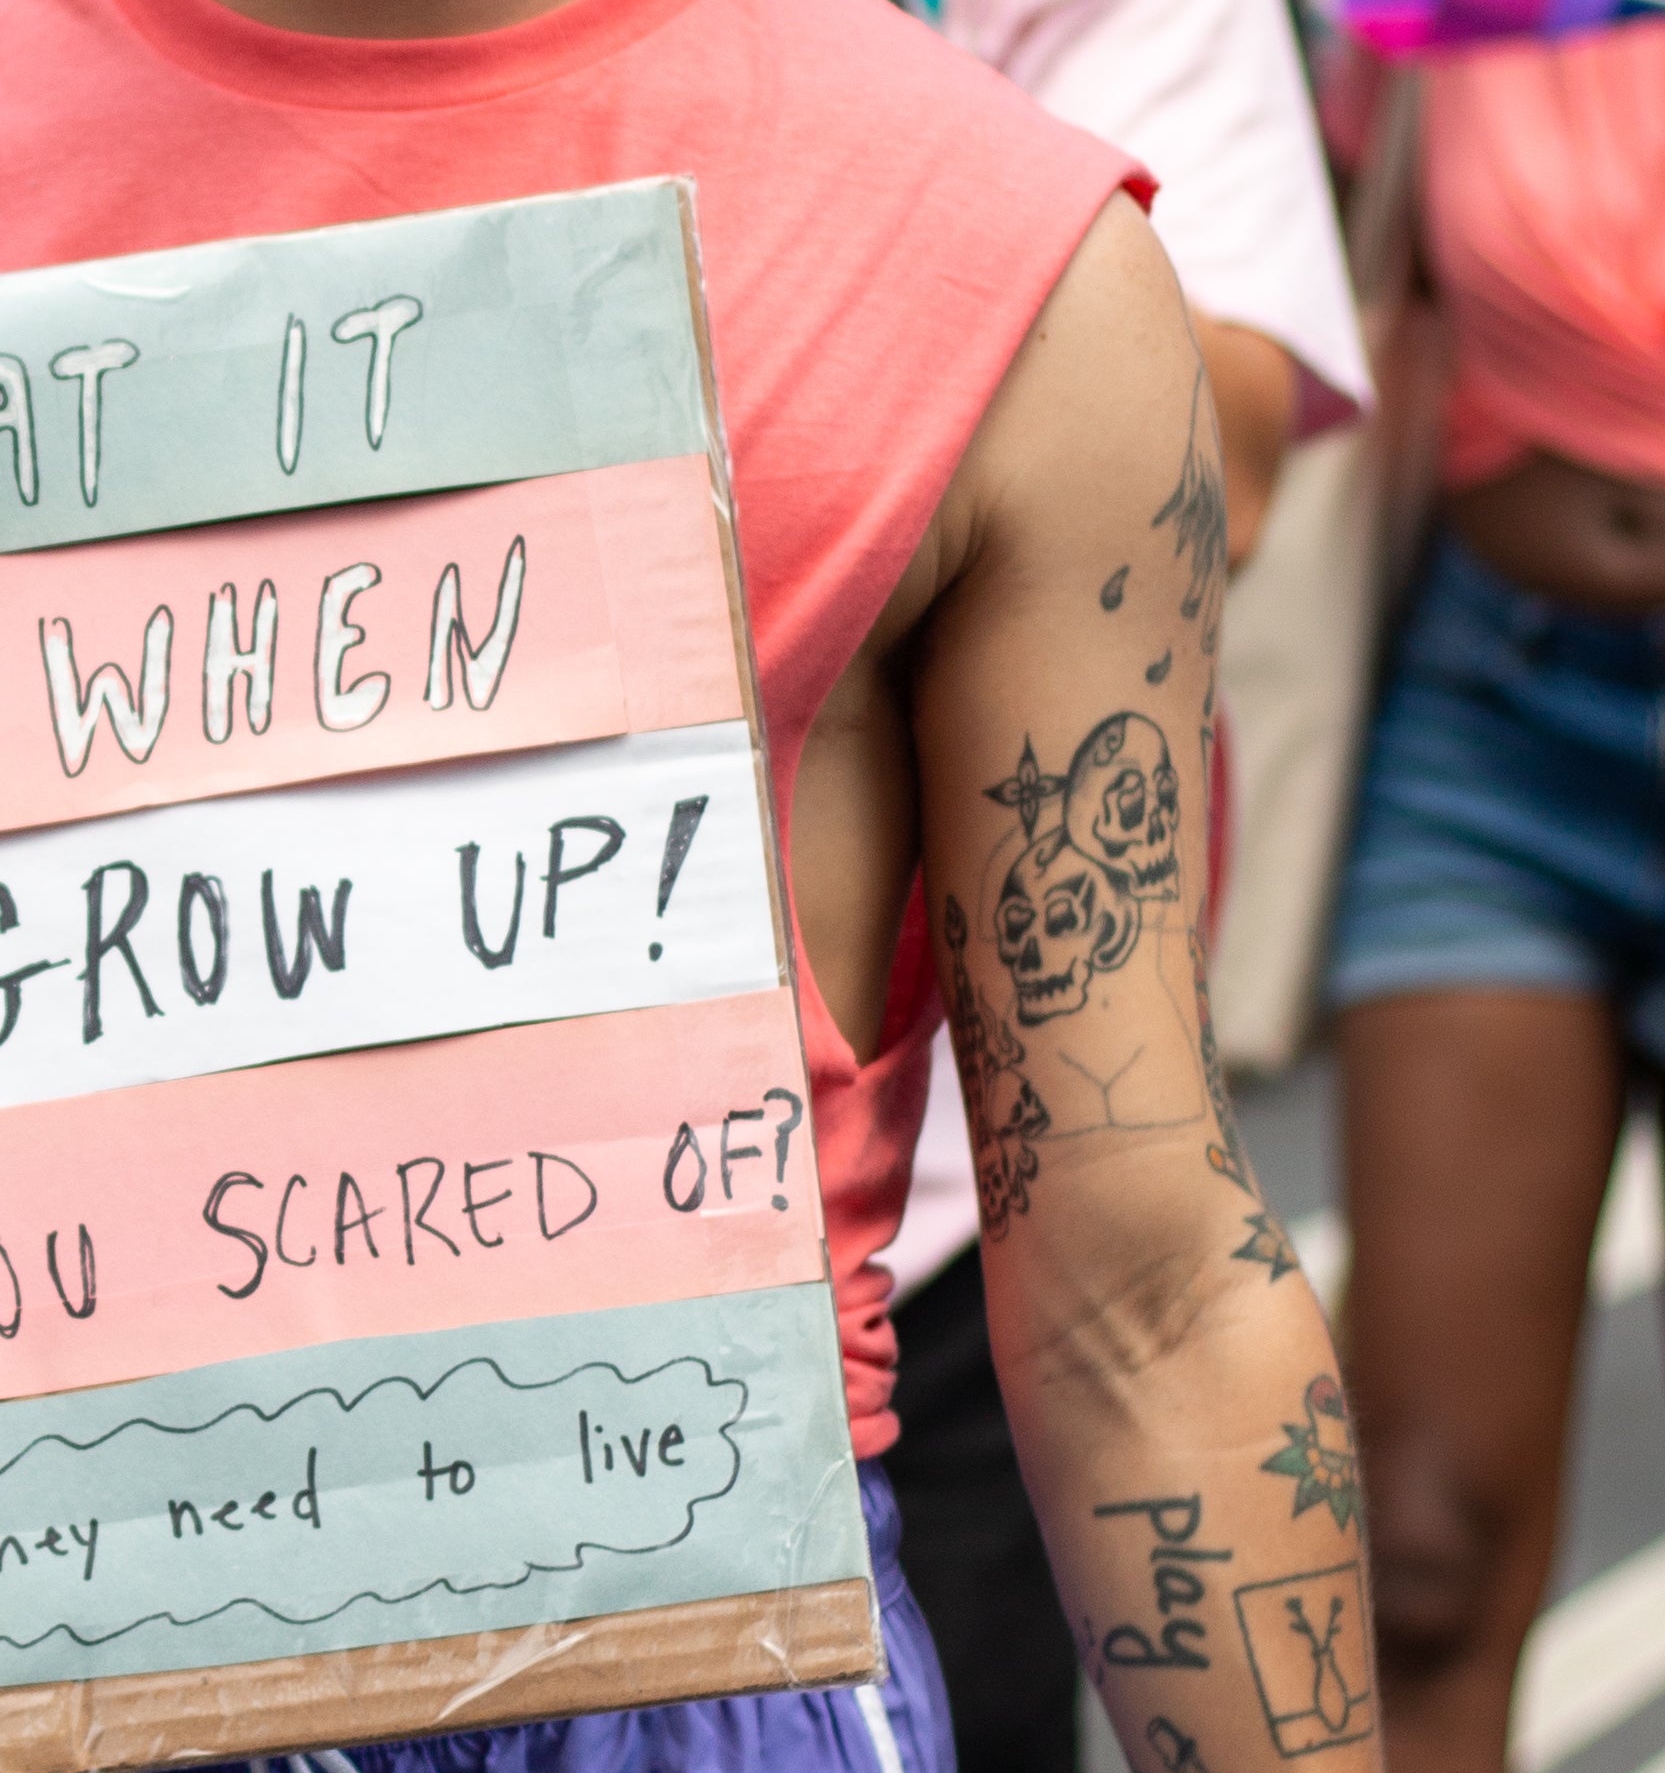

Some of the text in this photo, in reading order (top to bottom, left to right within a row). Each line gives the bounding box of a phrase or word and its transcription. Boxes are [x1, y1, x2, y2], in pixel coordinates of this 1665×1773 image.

[277, 294, 424, 476] IT
[39, 533, 526, 778] WHEN
[454, 794, 710, 970] UP!
[202, 1150, 599, 1300] SCARED
[662, 1087, 805, 1213] OF?
[167, 1446, 323, 1540] need
[417, 1439, 478, 1503] to
[577, 1409, 687, 1485] live
[1093, 1493, 1234, 1671] play
